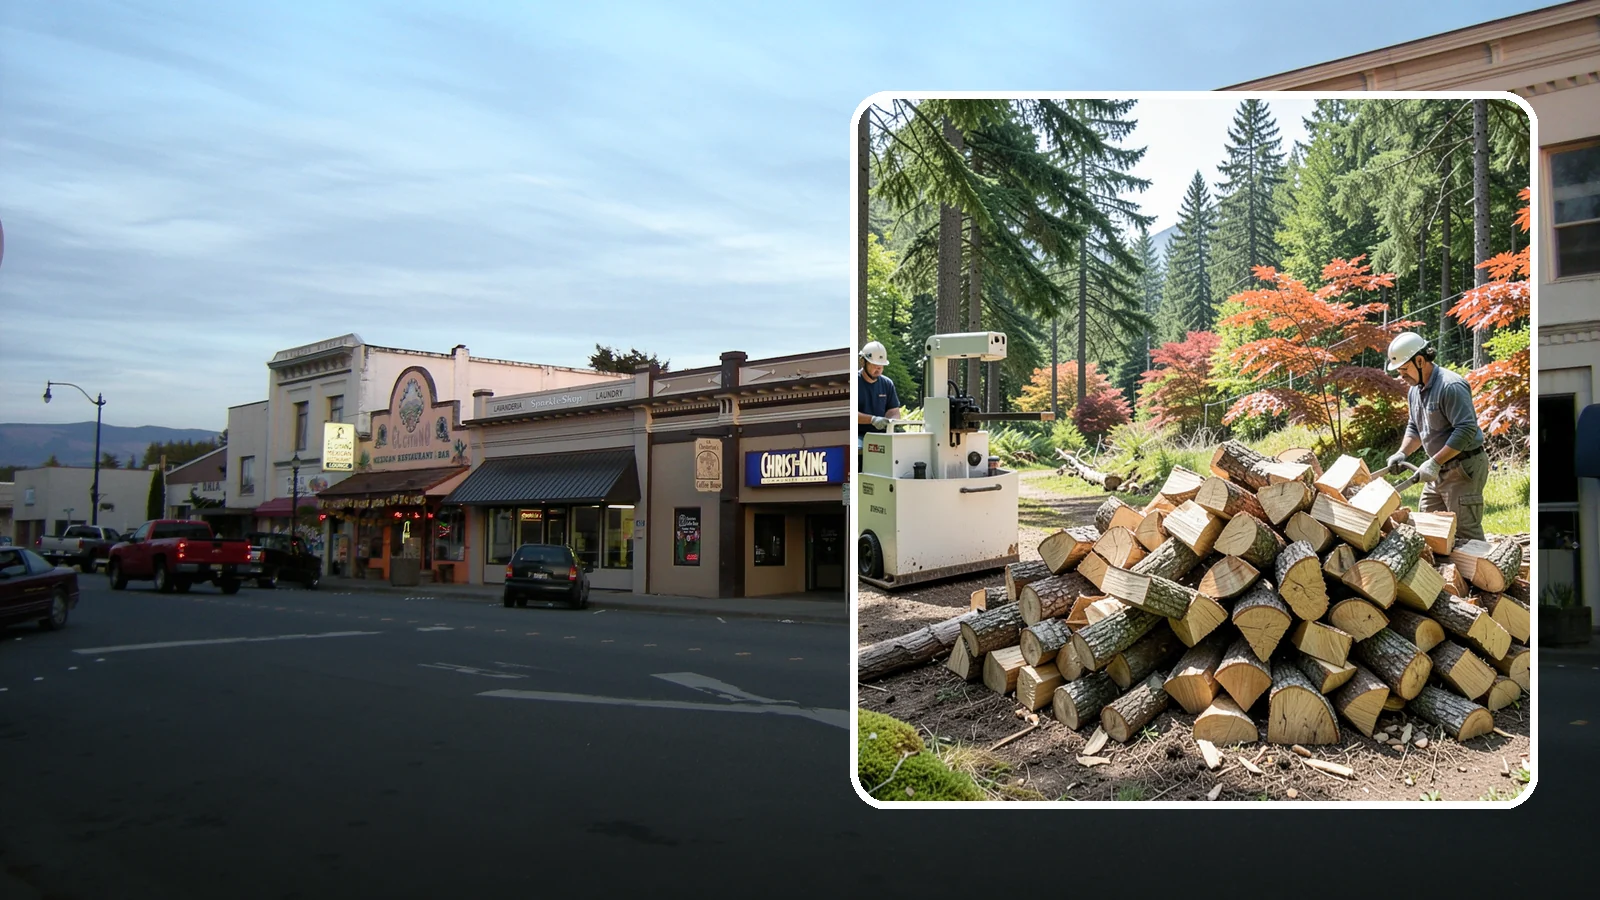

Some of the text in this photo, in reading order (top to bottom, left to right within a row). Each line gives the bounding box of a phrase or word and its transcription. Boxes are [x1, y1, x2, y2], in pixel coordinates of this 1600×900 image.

[493, 389, 624, 412] LAVANDERIA Sparkle Shop LAUNDRY
[373, 455, 396, 464] MEXICAN
[397, 451, 434, 462] RESTAURANT
[437, 450, 450, 459] BAR
[761, 450, 827, 478] CHRIST KING
[696, 481, 709, 489] Coffee
